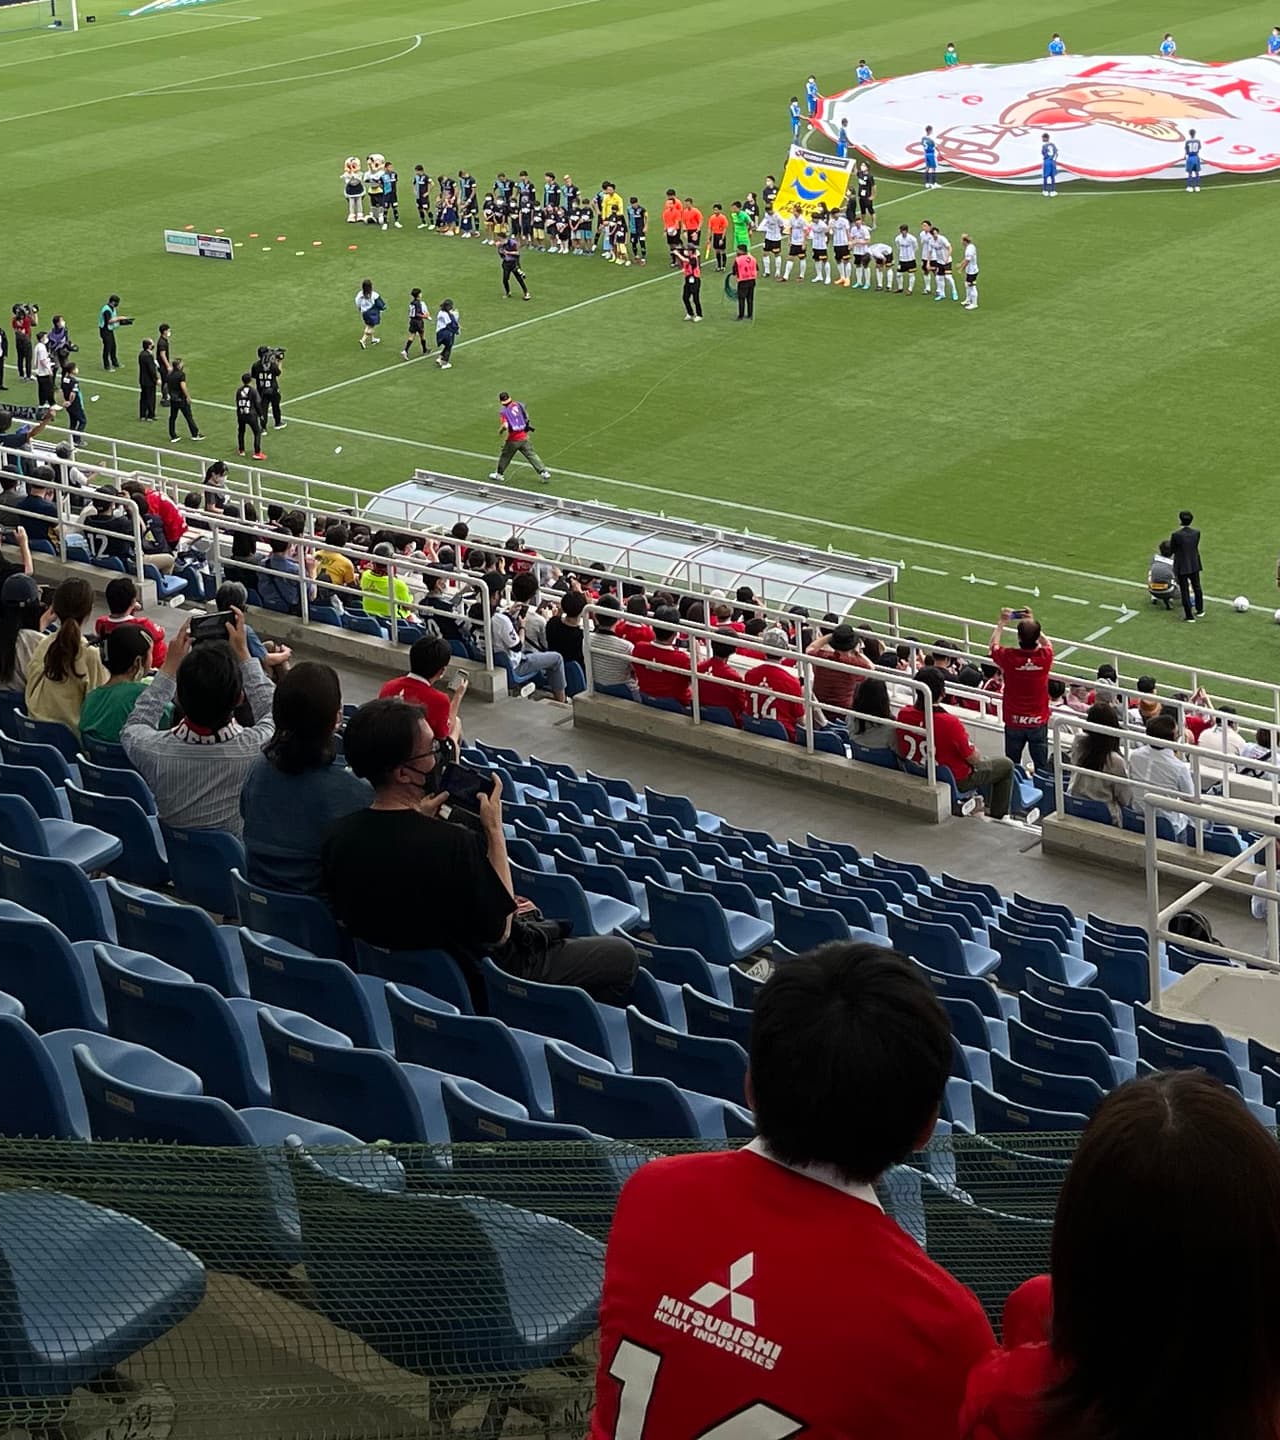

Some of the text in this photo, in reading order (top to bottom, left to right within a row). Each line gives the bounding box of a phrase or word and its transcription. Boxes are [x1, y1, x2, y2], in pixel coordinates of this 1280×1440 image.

[1187, 141, 1200, 153] 10
[86, 532, 110, 559] 12
[1020, 715, 1042, 725] KFC
[654, 1310, 776, 1371] HEAVY INDUSTRIES
[658, 1295, 783, 1360] MITSUBISHI
